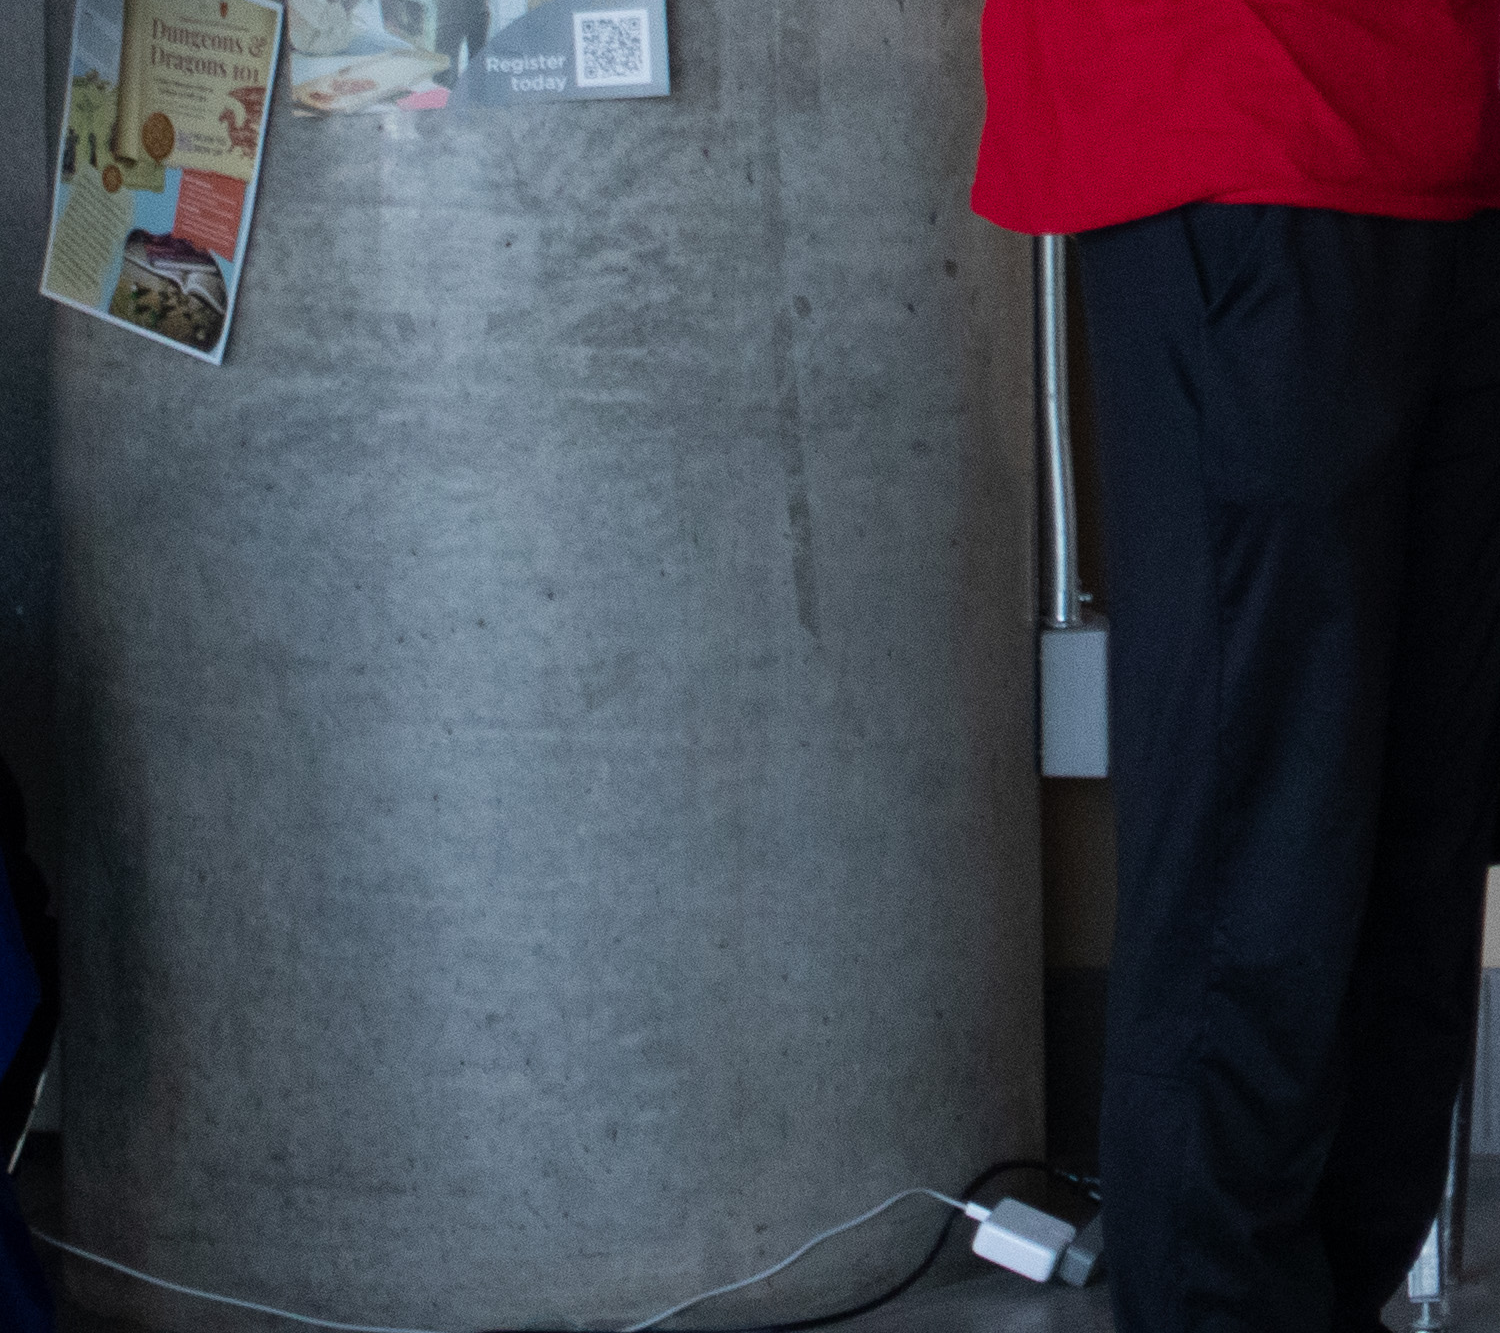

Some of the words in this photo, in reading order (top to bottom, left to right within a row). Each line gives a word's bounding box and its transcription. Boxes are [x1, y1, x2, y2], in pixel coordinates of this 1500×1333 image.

[152, 17, 244, 54] Dungeons
[248, 35, 268, 59] &
[151, 44, 228, 79] Dragons
[233, 63, 260, 83] 101
[485, 54, 567, 75] Register
[510, 74, 568, 93] today
